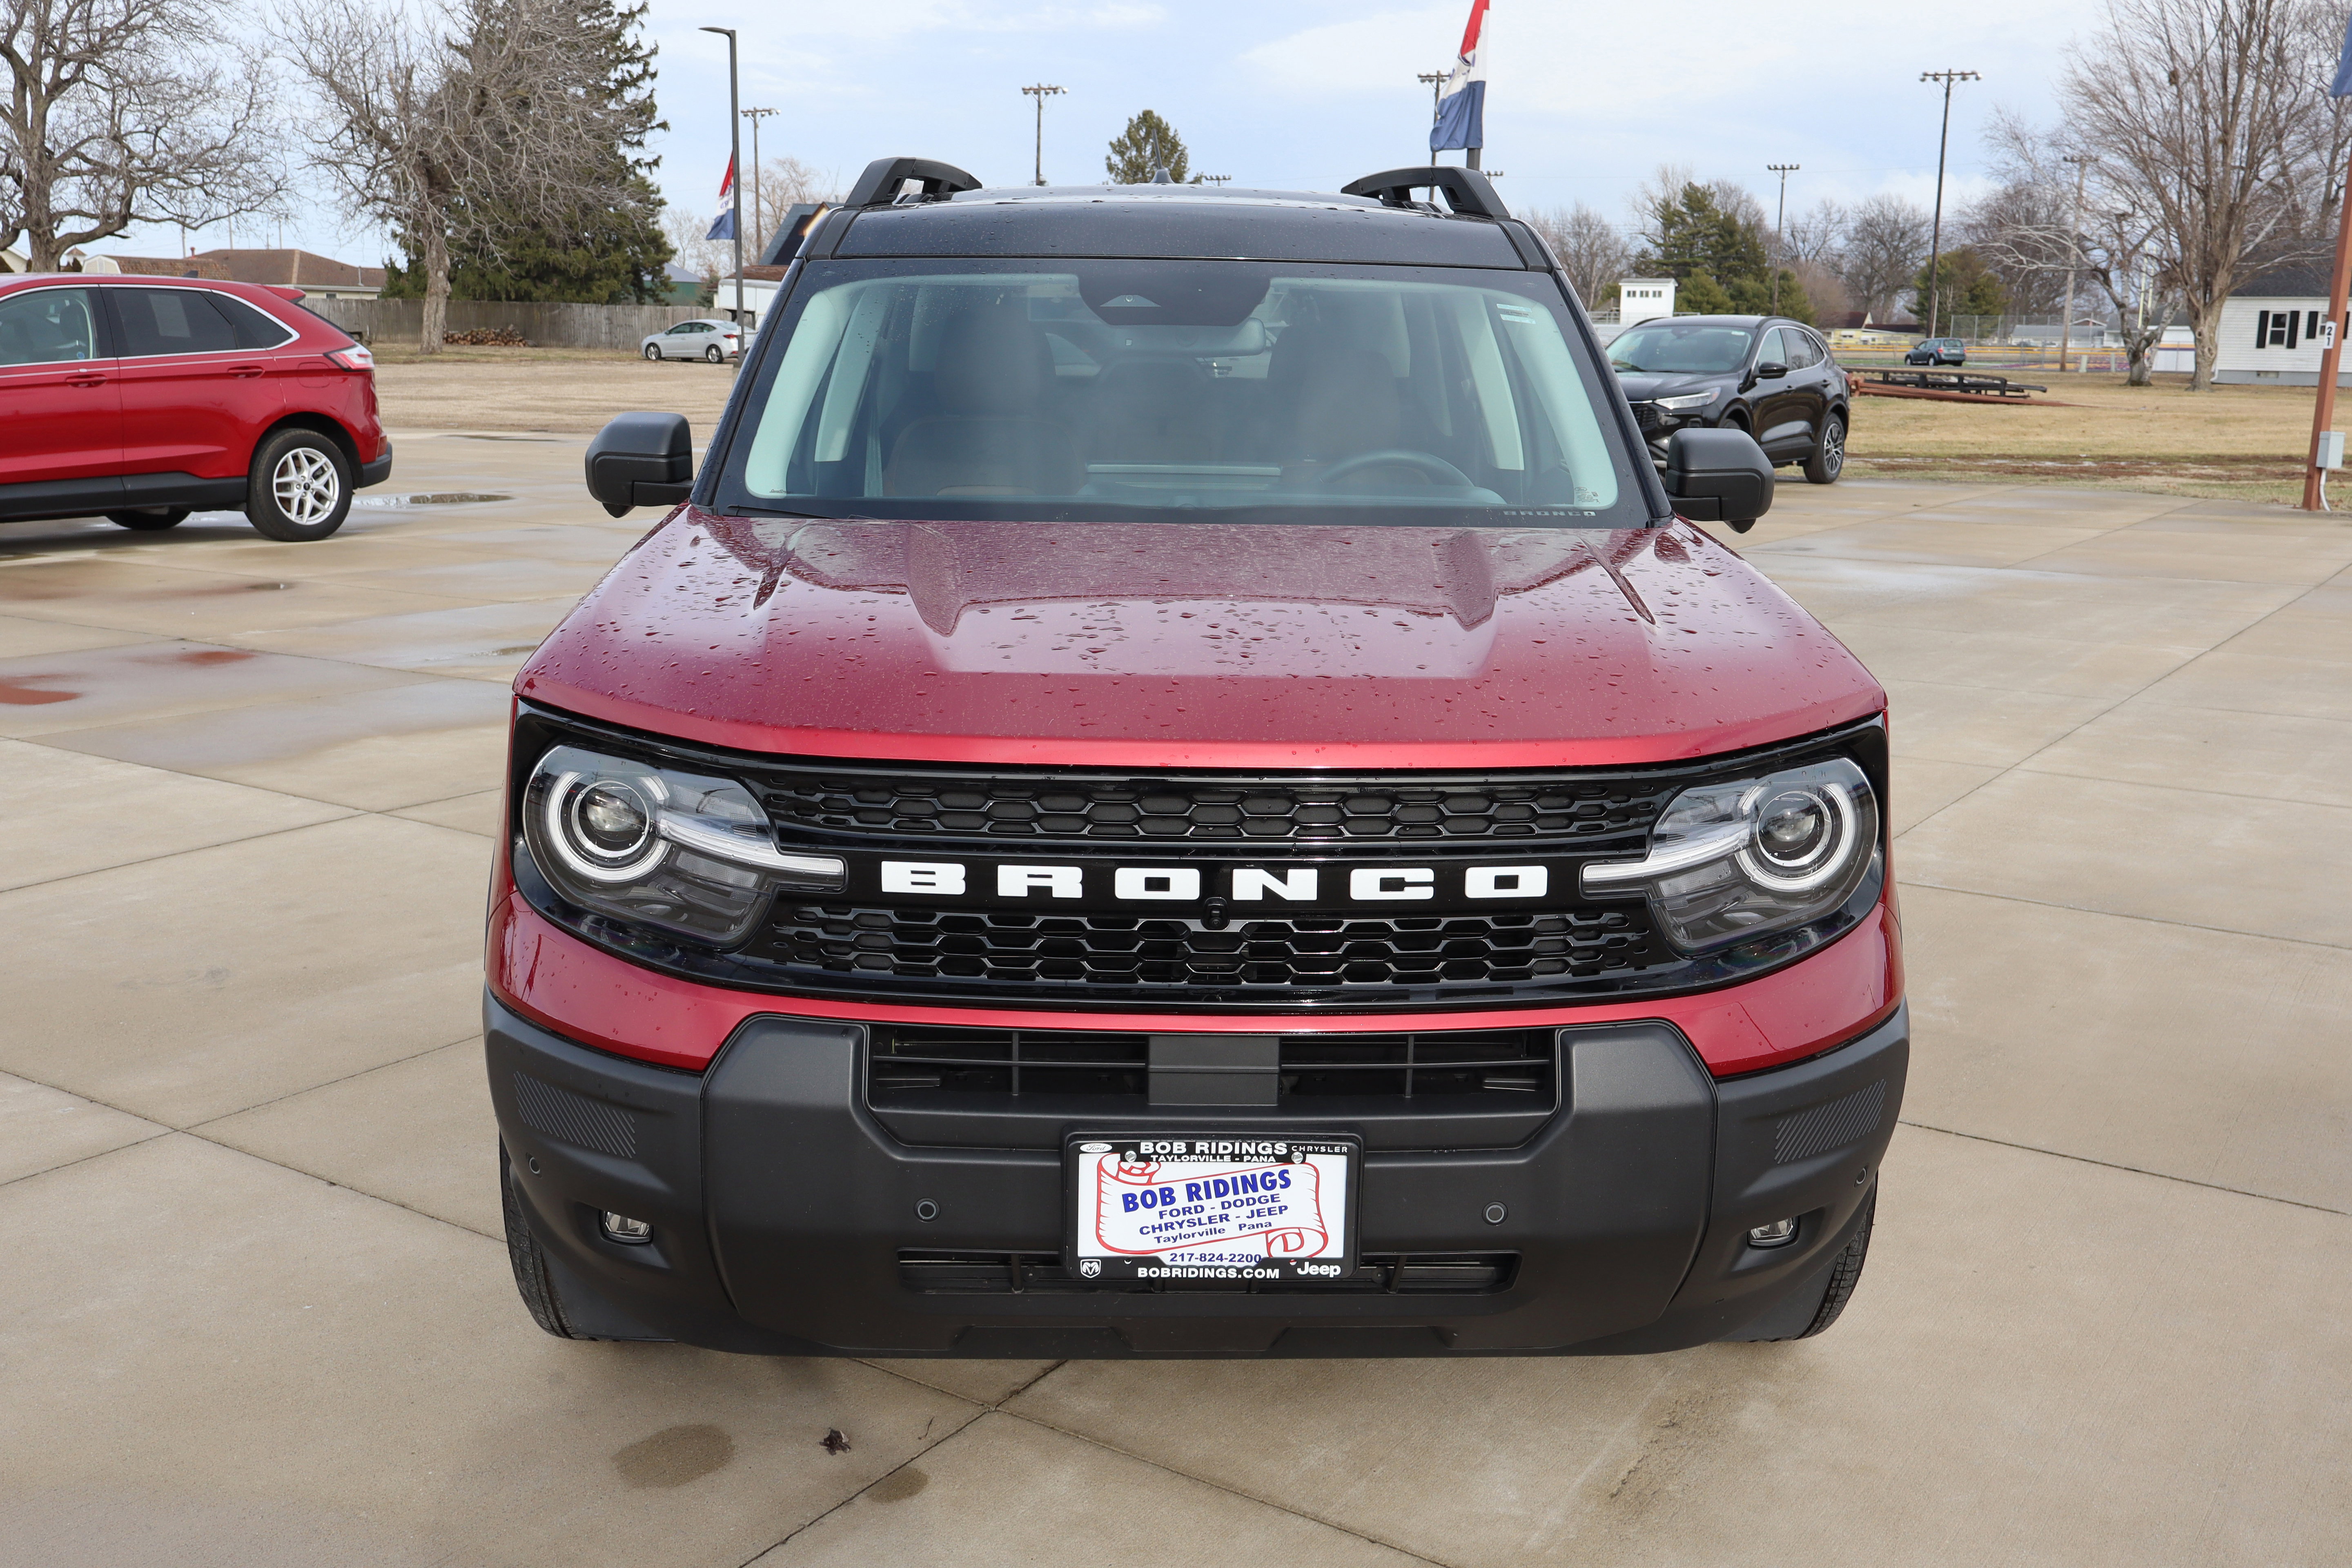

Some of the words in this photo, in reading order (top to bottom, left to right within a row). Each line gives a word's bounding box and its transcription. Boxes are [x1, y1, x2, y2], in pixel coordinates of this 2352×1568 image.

[880, 860, 1548, 901] BRONCO
[1140, 1142, 1187, 1154] BOB
[1195, 1142, 1287, 1155] RIDINGS
[1122, 1187, 1176, 1213] BOB
[1185, 1169, 1292, 1202] RIDINGS
[1158, 1205, 1205, 1219] FORD
[1221, 1194, 1281, 1210] DODGE
[1139, 1213, 1231, 1235] CHRYSLER
[1246, 1205, 1289, 1219] JEEP
[1154, 1227, 1226, 1244] Taylorville
[1238, 1221, 1272, 1231] Pana
[1169, 1253, 1262, 1263] 217-824-2200
[1138, 1267, 1279, 1278] BOBRIDINGS.COM
[1297, 1262, 1341, 1278] Jeep
